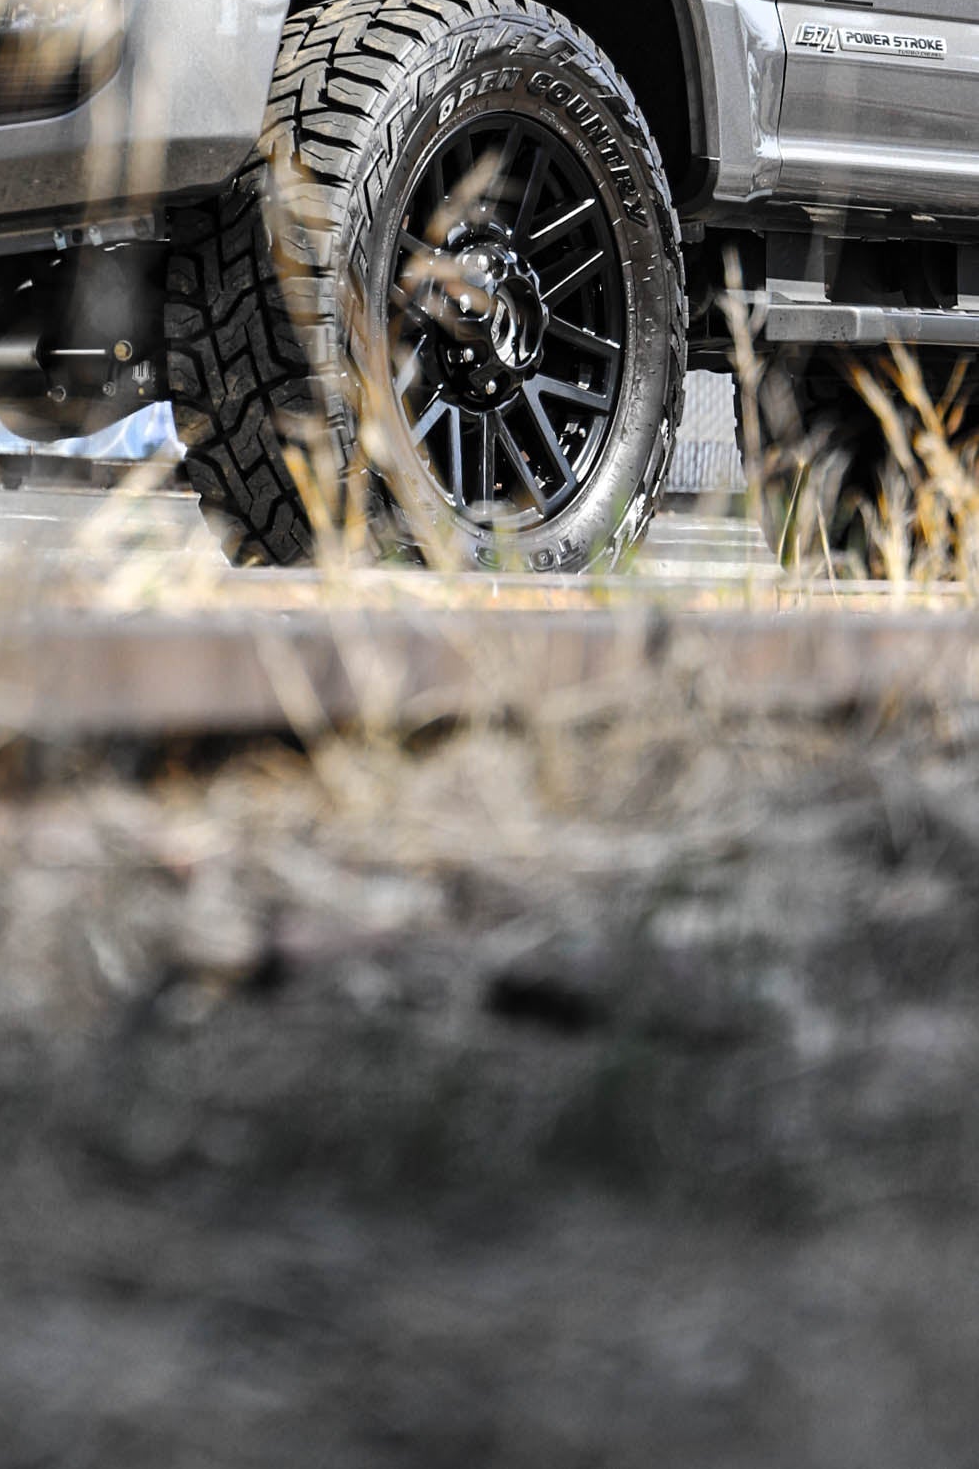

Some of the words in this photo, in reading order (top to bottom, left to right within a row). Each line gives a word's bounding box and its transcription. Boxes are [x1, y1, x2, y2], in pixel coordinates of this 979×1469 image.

[845, 31, 890, 47] POWER
[893, 36, 944, 51] STROKE
[437, 67, 523, 126] OPEN
[526, 71, 649, 228] COUNTRY
